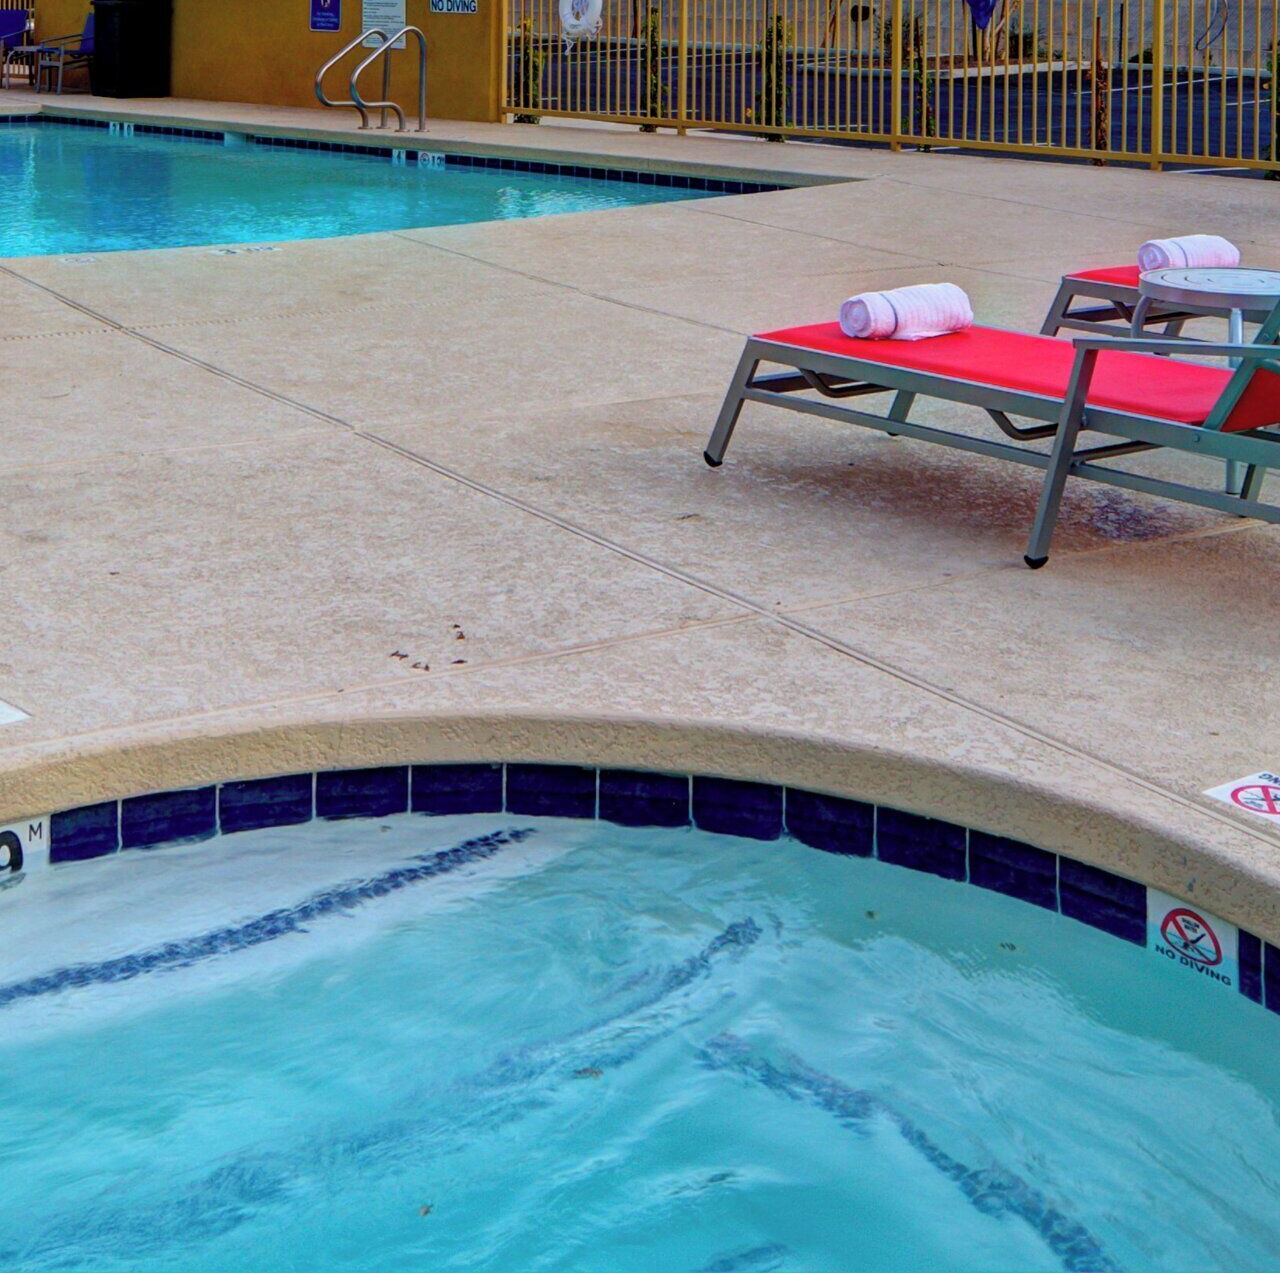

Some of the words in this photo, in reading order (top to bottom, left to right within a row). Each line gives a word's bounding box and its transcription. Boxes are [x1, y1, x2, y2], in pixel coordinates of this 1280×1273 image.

[431, 0, 444, 11] NO
[446, 0, 476, 12] DIVING
[28, 822, 42, 842] M
[1155, 944, 1176, 960] NO
[1179, 957, 1232, 986] DIVING
